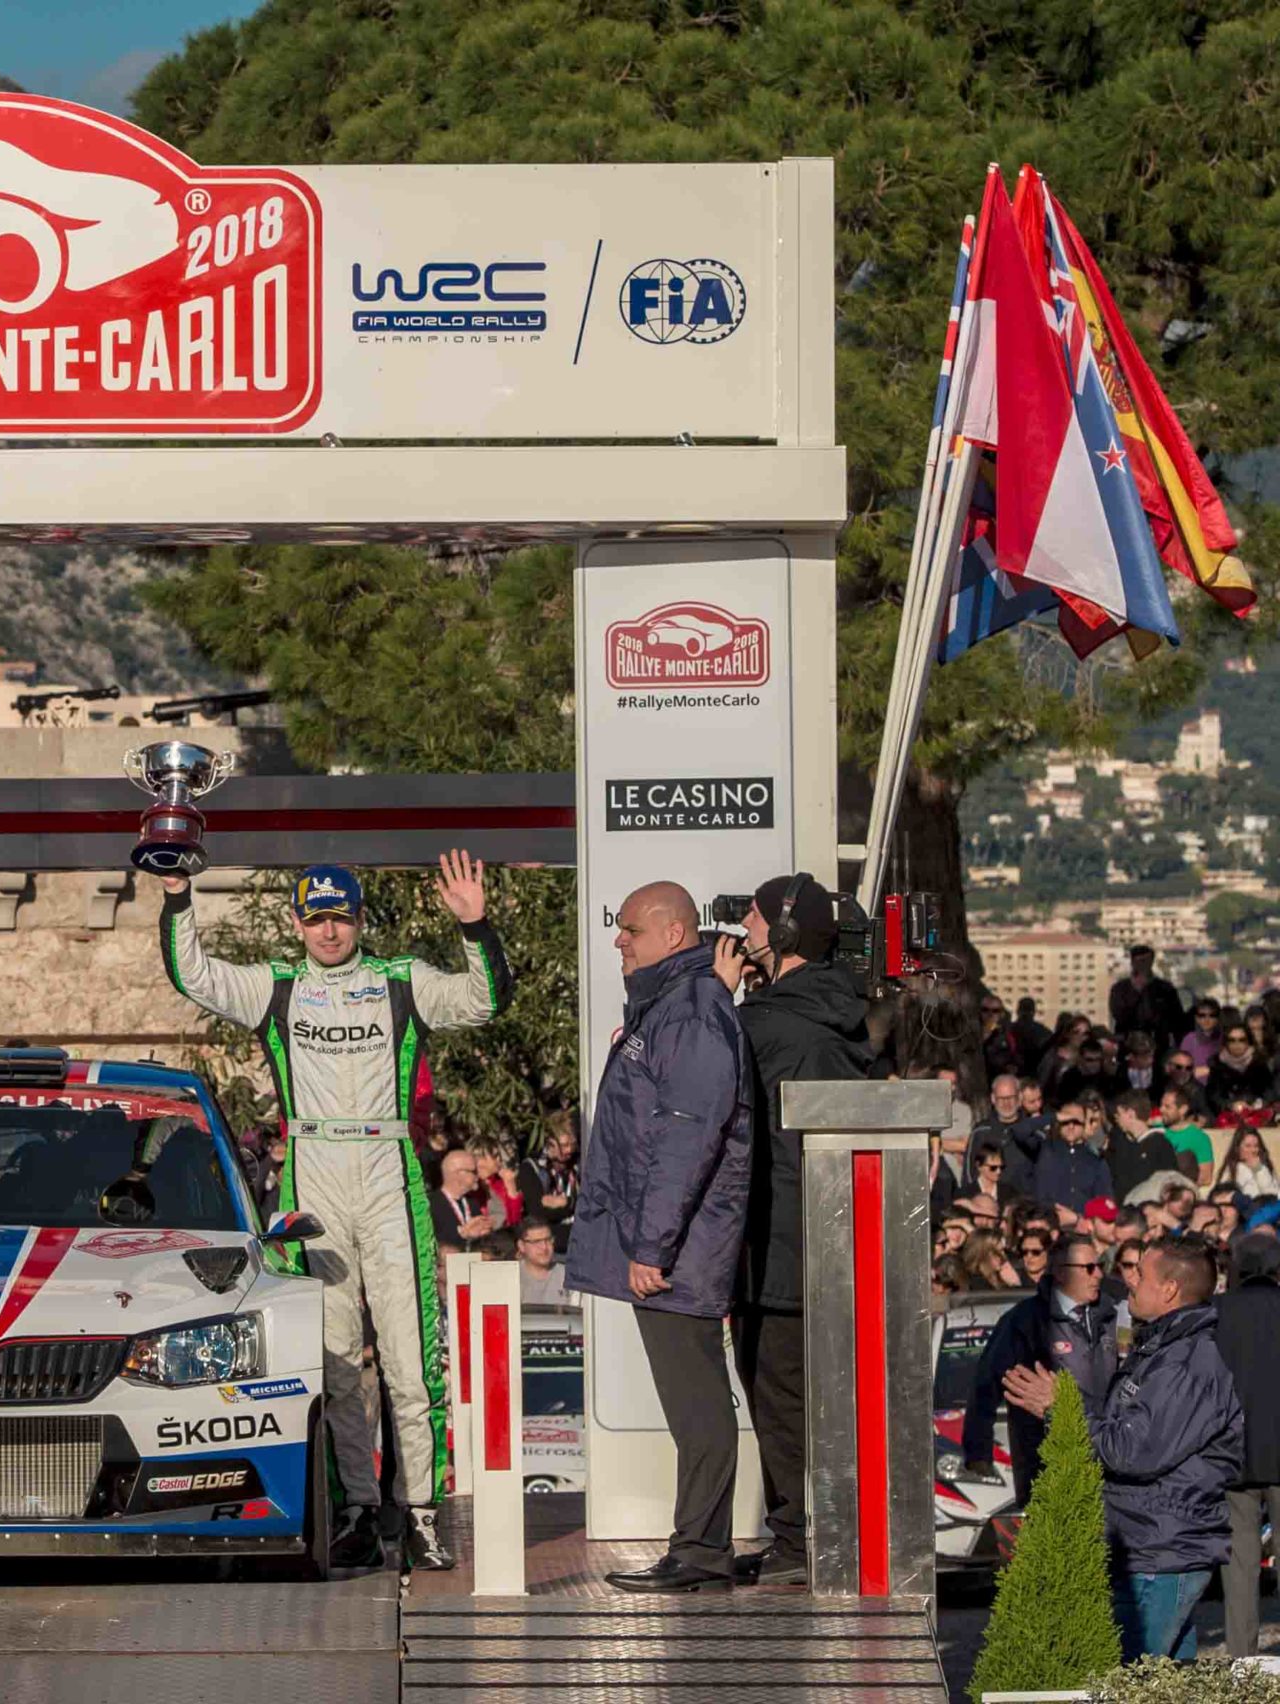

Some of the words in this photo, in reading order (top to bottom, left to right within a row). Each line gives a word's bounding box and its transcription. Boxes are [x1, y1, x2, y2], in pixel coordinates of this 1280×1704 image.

[184, 197, 284, 279] 2018
[352, 262, 547, 301] WRC
[357, 316, 388, 327] FIA
[393, 316, 466, 327] WORLD
[471, 316, 542, 327] RALLY
[358, 335, 542, 344] CHAMPIONSHIP
[617, 632, 643, 652] 2018
[732, 630, 759, 651] 2018
[616, 645, 661, 678] RALLYE
[665, 645, 760, 677] MONTE-CARLO
[617, 693, 760, 711] #RallyeMonteCarlo
[610, 784, 640, 809] LE
[647, 782, 769, 809] CASINO
[138, 850, 203, 869] ACM
[293, 1018, 384, 1043] ŠKODA
[249, 1381, 304, 1395] MICHELIN
[156, 1411, 283, 1449] ŠKODA
[157, 1476, 190, 1491] Castrol
[191, 1470, 249, 1490] EDGE
